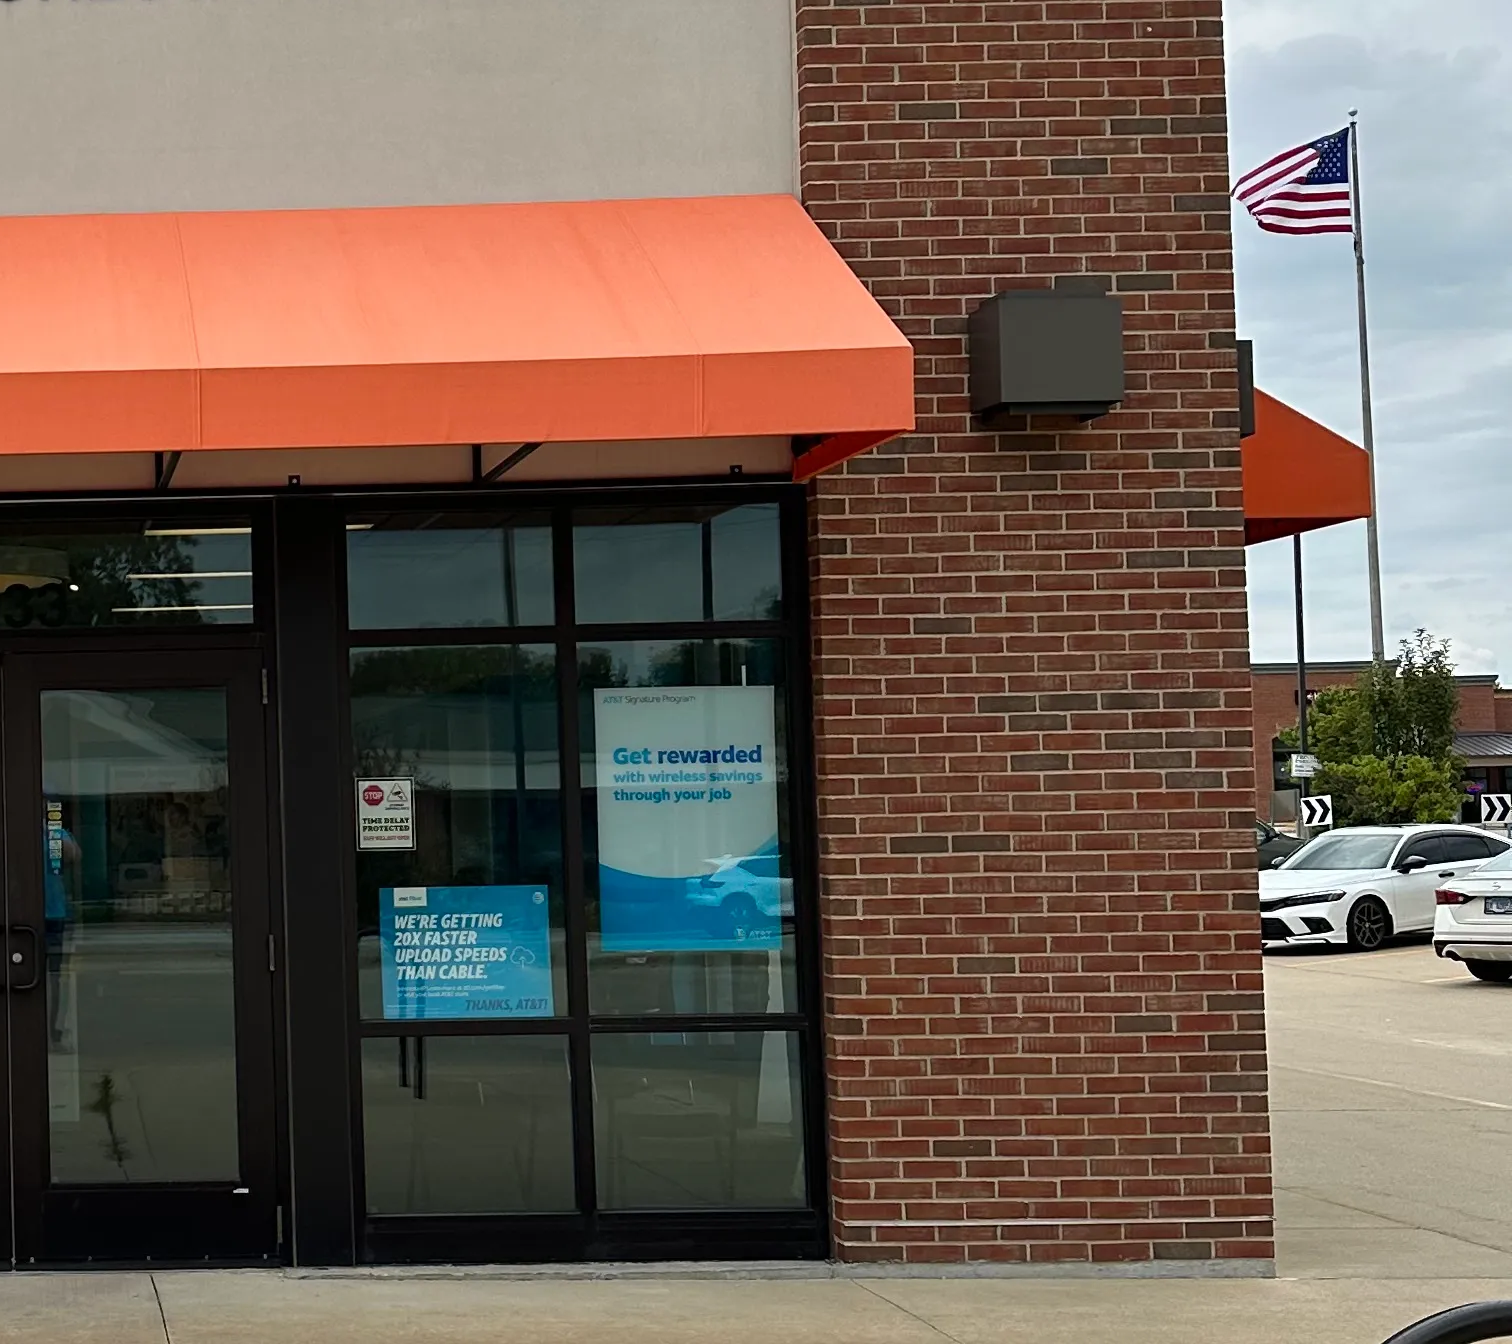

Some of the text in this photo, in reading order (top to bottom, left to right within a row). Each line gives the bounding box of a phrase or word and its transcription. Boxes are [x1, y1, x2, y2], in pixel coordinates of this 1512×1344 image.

[624, 695, 661, 705] Signature
[662, 694, 696, 705] Program
[612, 744, 762, 765] Get rewarded
[613, 769, 763, 785] with wireless savings
[364, 791, 383, 800] STOP
[613, 787, 732, 804] through your job
[362, 817, 383, 825] TIME
[394, 912, 504, 930] WE'RE GETTING
[393, 930, 478, 947] 20X FASTER
[395, 946, 508, 963] UPLOAD SPEEDS
[396, 964, 489, 981] THAN CABLE.
[464, 997, 548, 1013] THANKS, AT&T!
